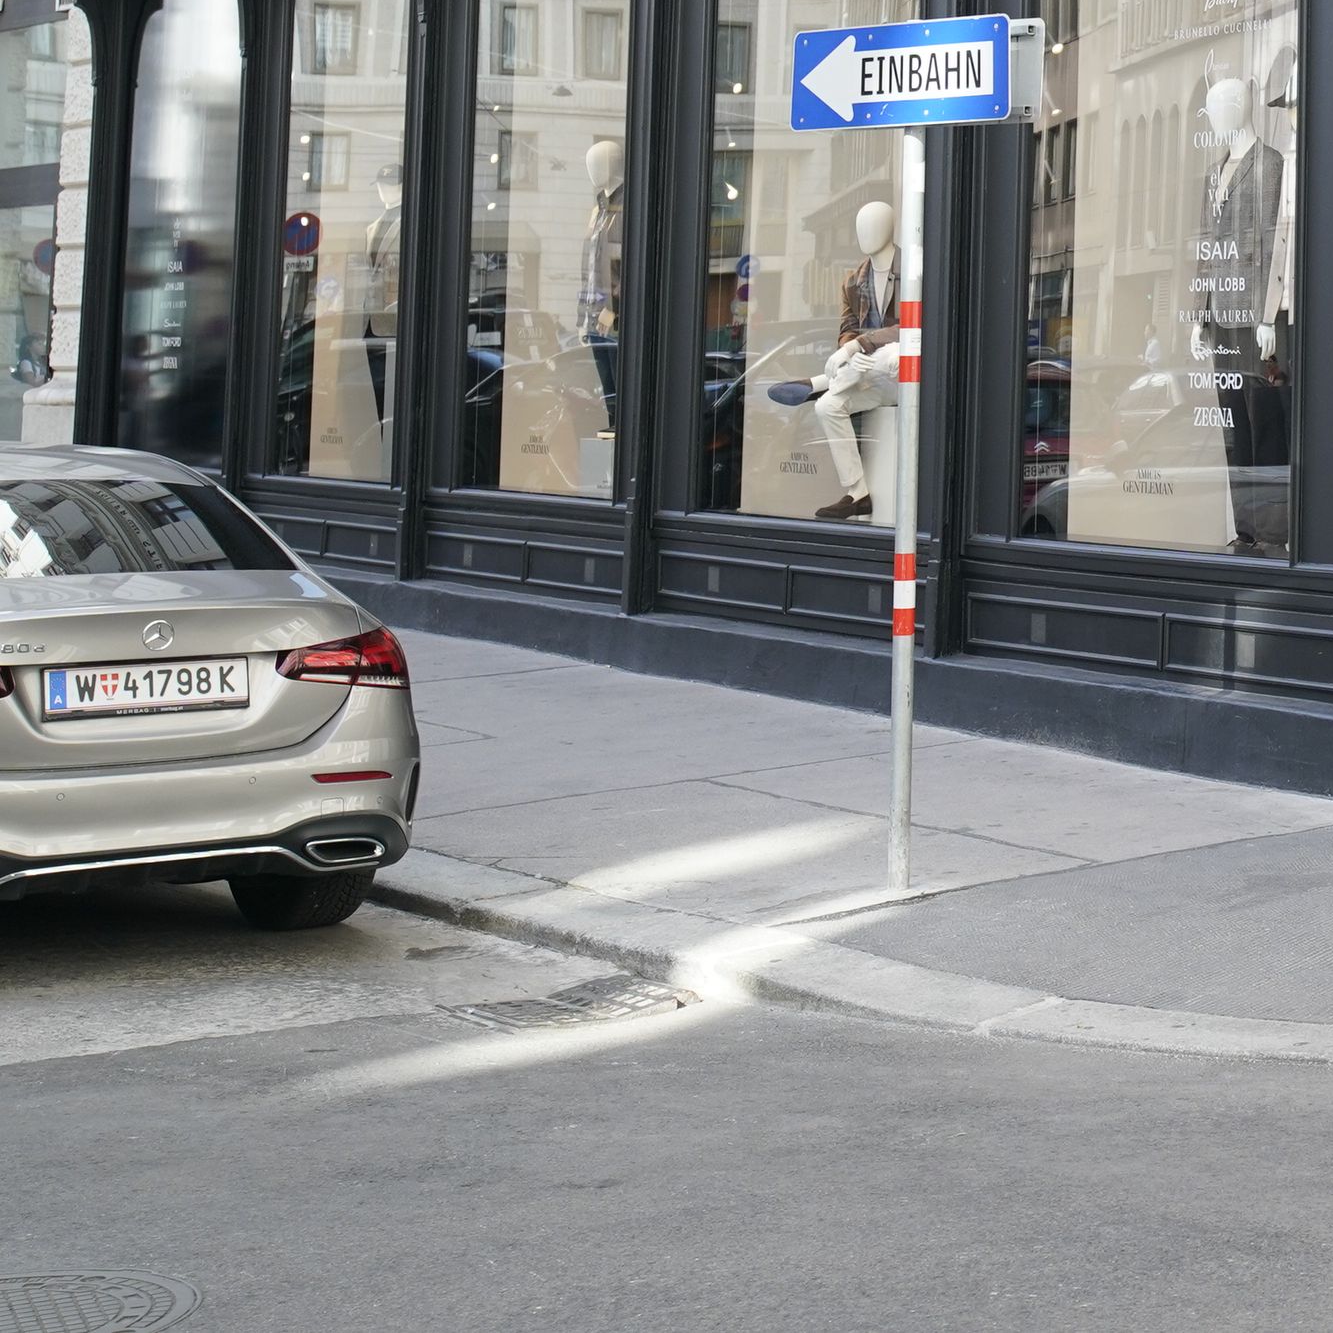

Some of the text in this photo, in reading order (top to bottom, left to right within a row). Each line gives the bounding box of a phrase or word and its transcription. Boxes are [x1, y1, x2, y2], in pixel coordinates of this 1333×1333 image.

[1173, 24, 1220, 41] BRUNELLO
[860, 48, 982, 97] EINBAHN
[1195, 240, 1239, 261] ISAIA
[1188, 277, 1246, 293] JOHN LOBB
[1179, 309, 1255, 323] RALPH LAUREN
[1188, 372, 1244, 390] TOM FORD
[1193, 406, 1235, 429] ZEGNA
[779, 461, 818, 475] GENTLEMAN
[1122, 480, 1174, 495] GENTLEMAN
[75, 673, 97, 702] W
[54, 694, 62, 705] A
[116, 707, 150, 715] MERBAG
